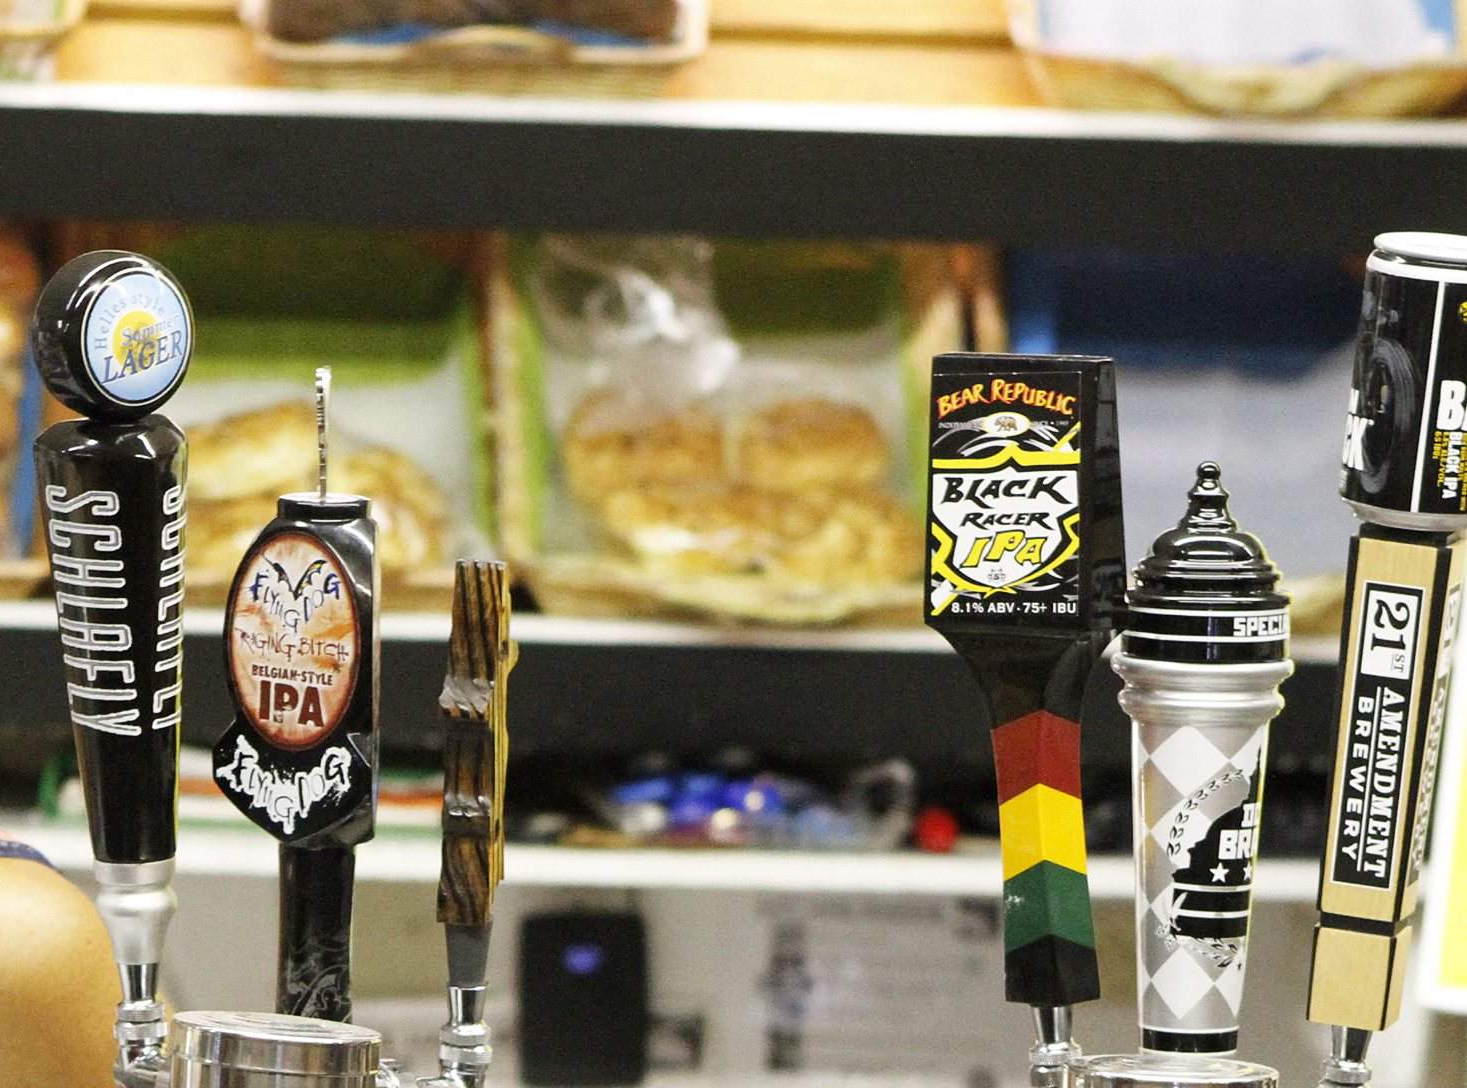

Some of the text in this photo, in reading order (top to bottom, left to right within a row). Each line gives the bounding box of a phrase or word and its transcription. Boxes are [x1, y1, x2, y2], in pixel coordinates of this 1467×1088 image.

[102, 330, 184, 384] LAGER
[936, 378, 1079, 419] BEAR REPUBLIC
[940, 475, 1073, 509] BLACK
[959, 512, 1055, 530] RACER
[959, 529, 1049, 568] IPA
[45, 484, 142, 737] SCHLAFLY
[950, 601, 1077, 614] 8.1% ABV 75+ IBU
[251, 663, 333, 686] BELGIAN-STYLE
[257, 679, 325, 728] IPA
[1341, 695, 1375, 864] BREWERY
[1364, 686, 1406, 878] AMENDMENT
